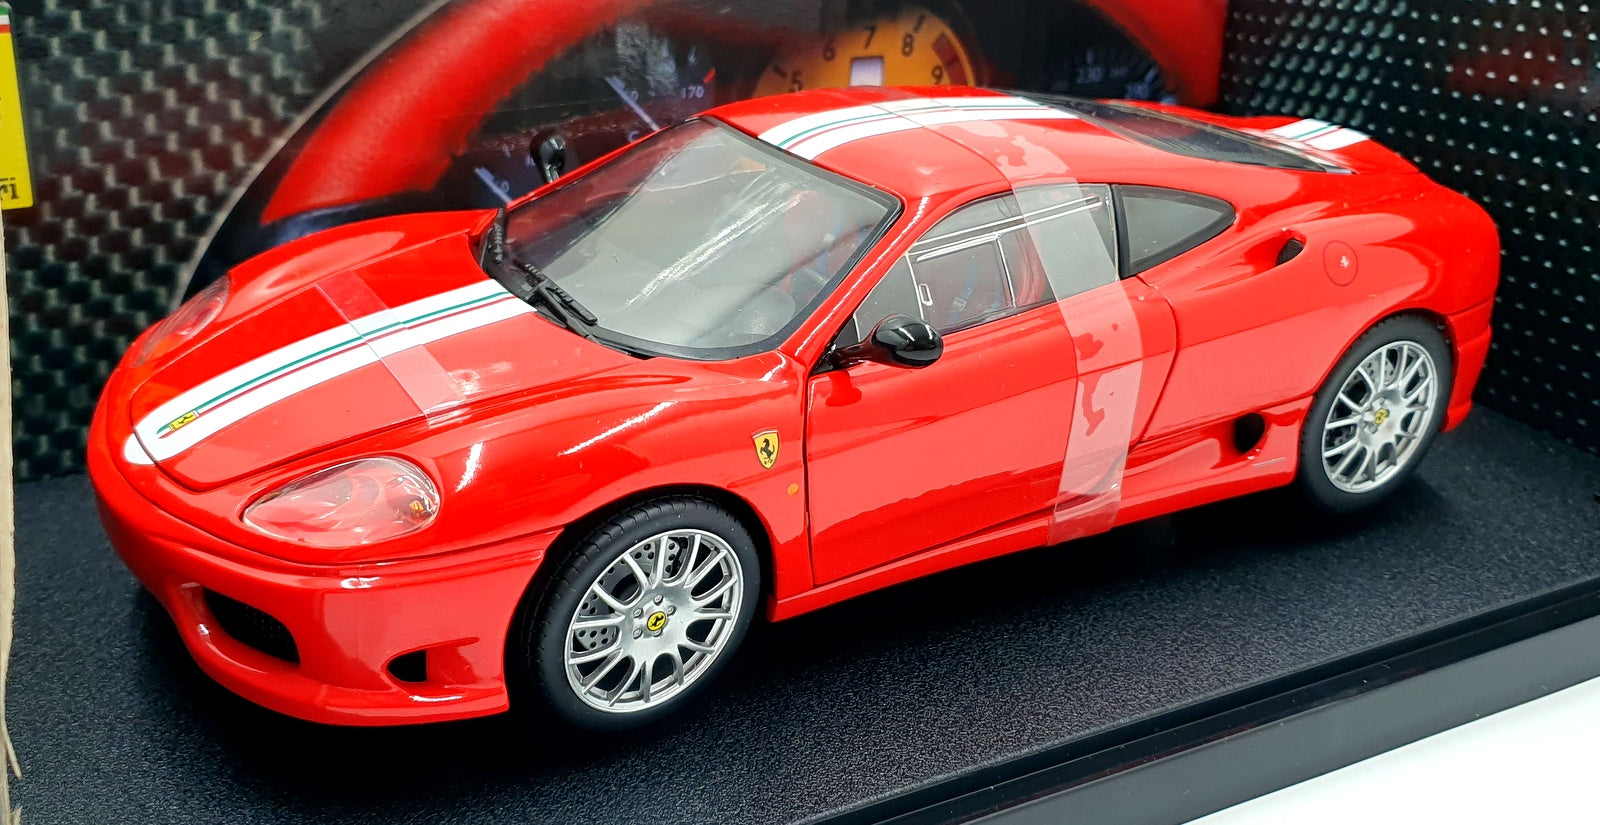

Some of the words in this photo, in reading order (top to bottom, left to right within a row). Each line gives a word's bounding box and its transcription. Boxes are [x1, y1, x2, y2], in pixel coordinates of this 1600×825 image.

[864, 26, 878, 49] 7
[902, 33, 915, 57] 8
[823, 38, 836, 62] 6
[931, 65, 944, 86] 9
